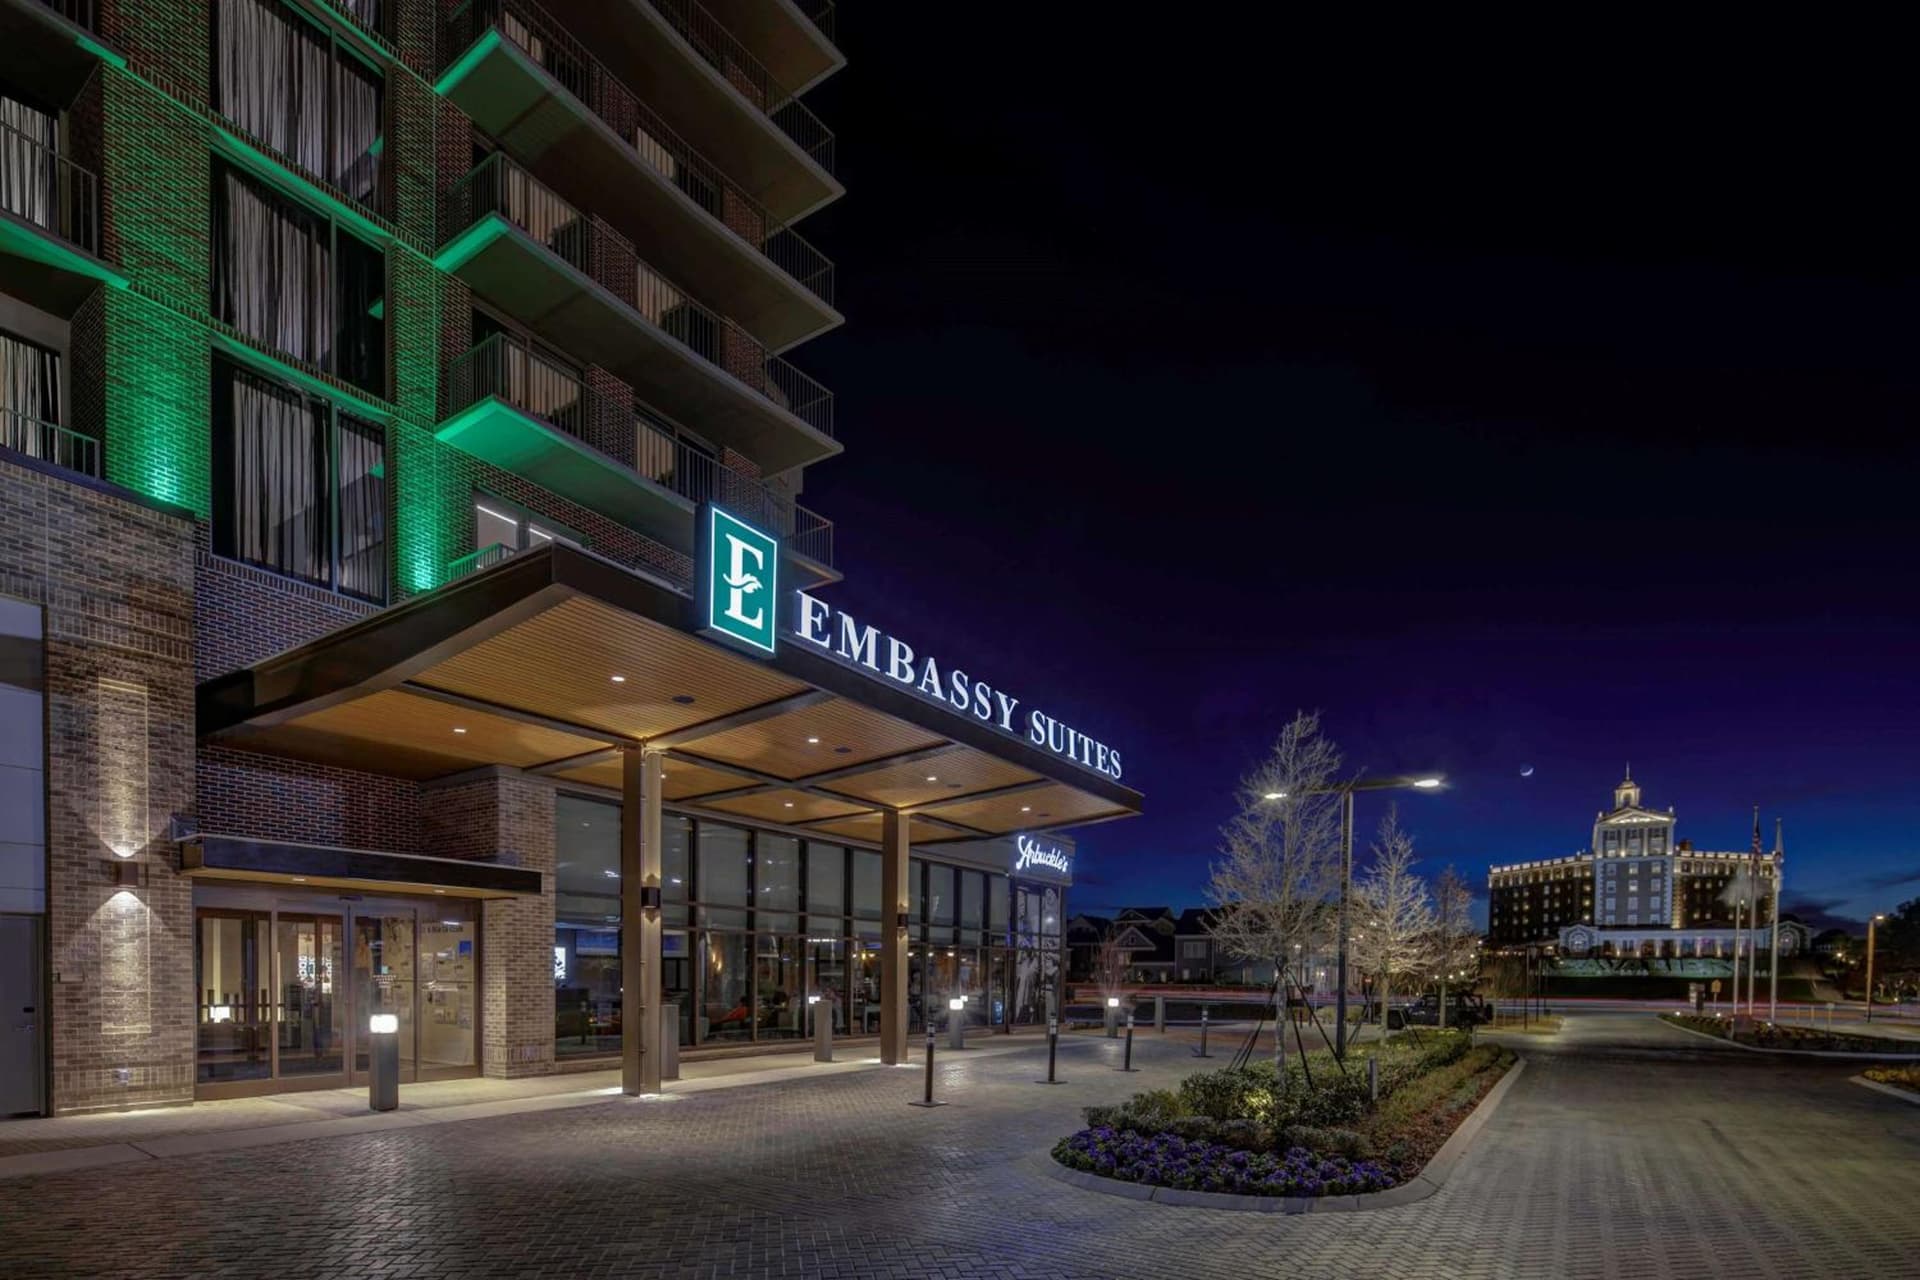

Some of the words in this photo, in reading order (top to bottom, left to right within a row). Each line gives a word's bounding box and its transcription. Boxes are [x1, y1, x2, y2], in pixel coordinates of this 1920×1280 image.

[795, 589, 1019, 732] EMBASSY
[1031, 710, 1122, 779] SUITES
[1015, 835, 1069, 873] Arbuckle's
